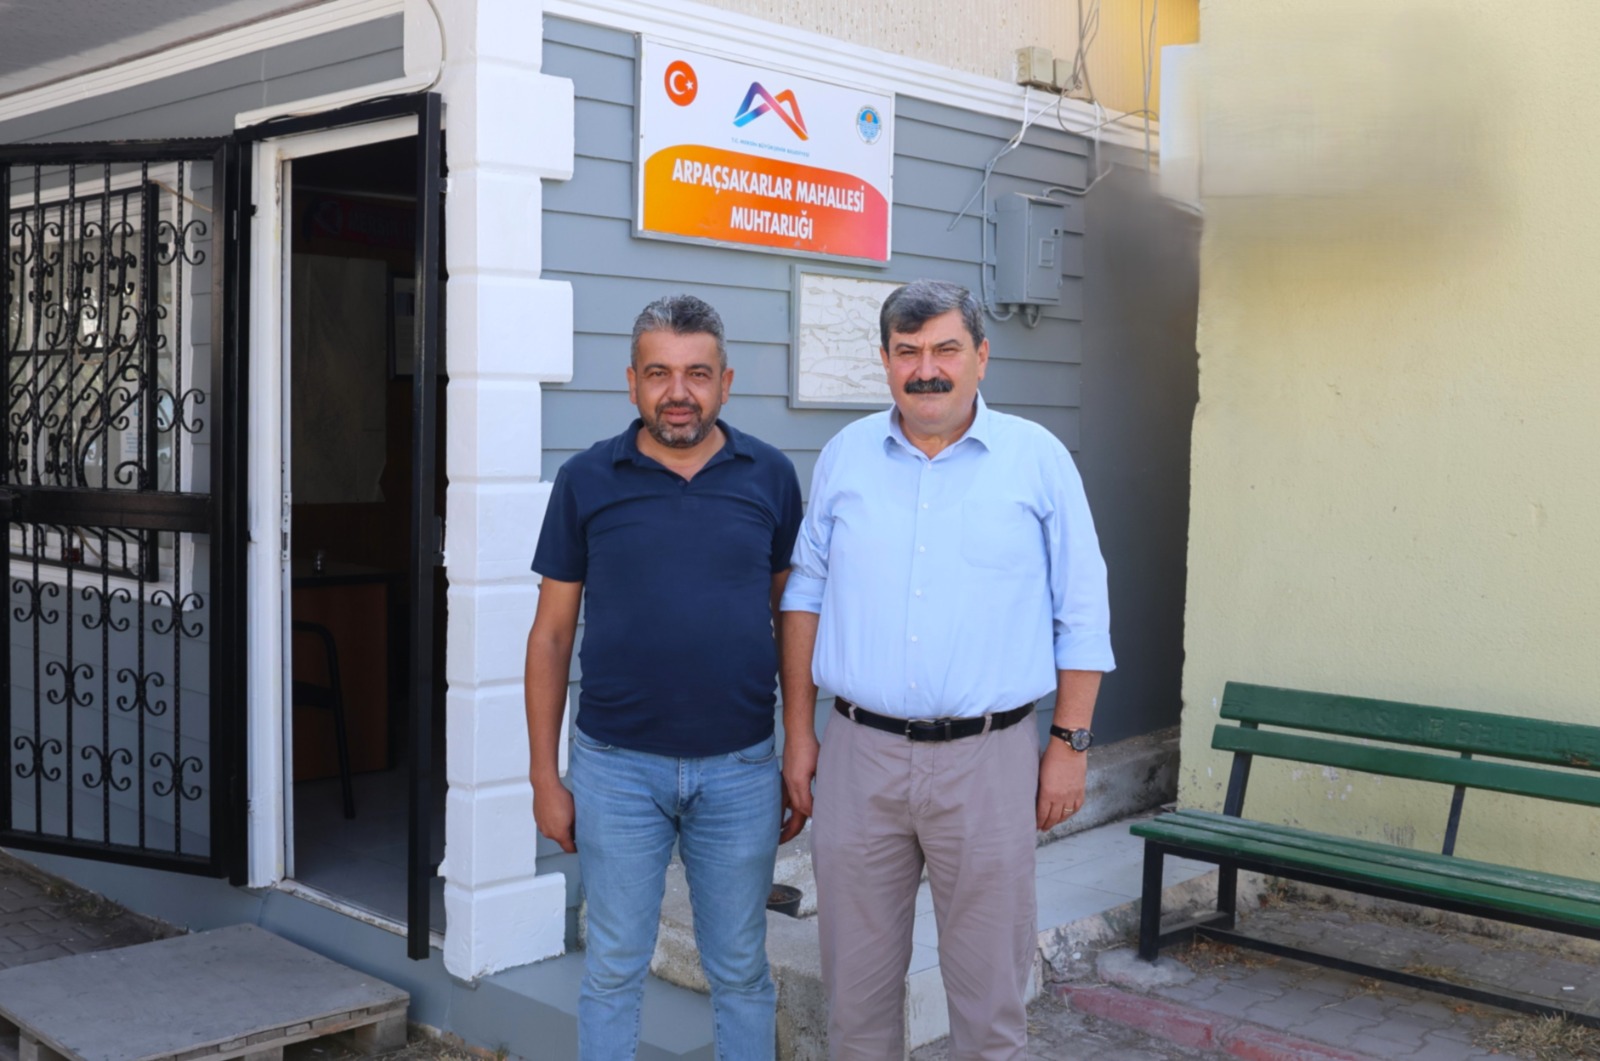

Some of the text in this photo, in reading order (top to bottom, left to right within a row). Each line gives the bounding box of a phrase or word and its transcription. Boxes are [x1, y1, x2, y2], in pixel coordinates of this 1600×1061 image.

[672, 158, 864, 213] ARPAÇSAKARLAR MAHALLESİ
[730, 206, 813, 240] MUHTARLIĞI
